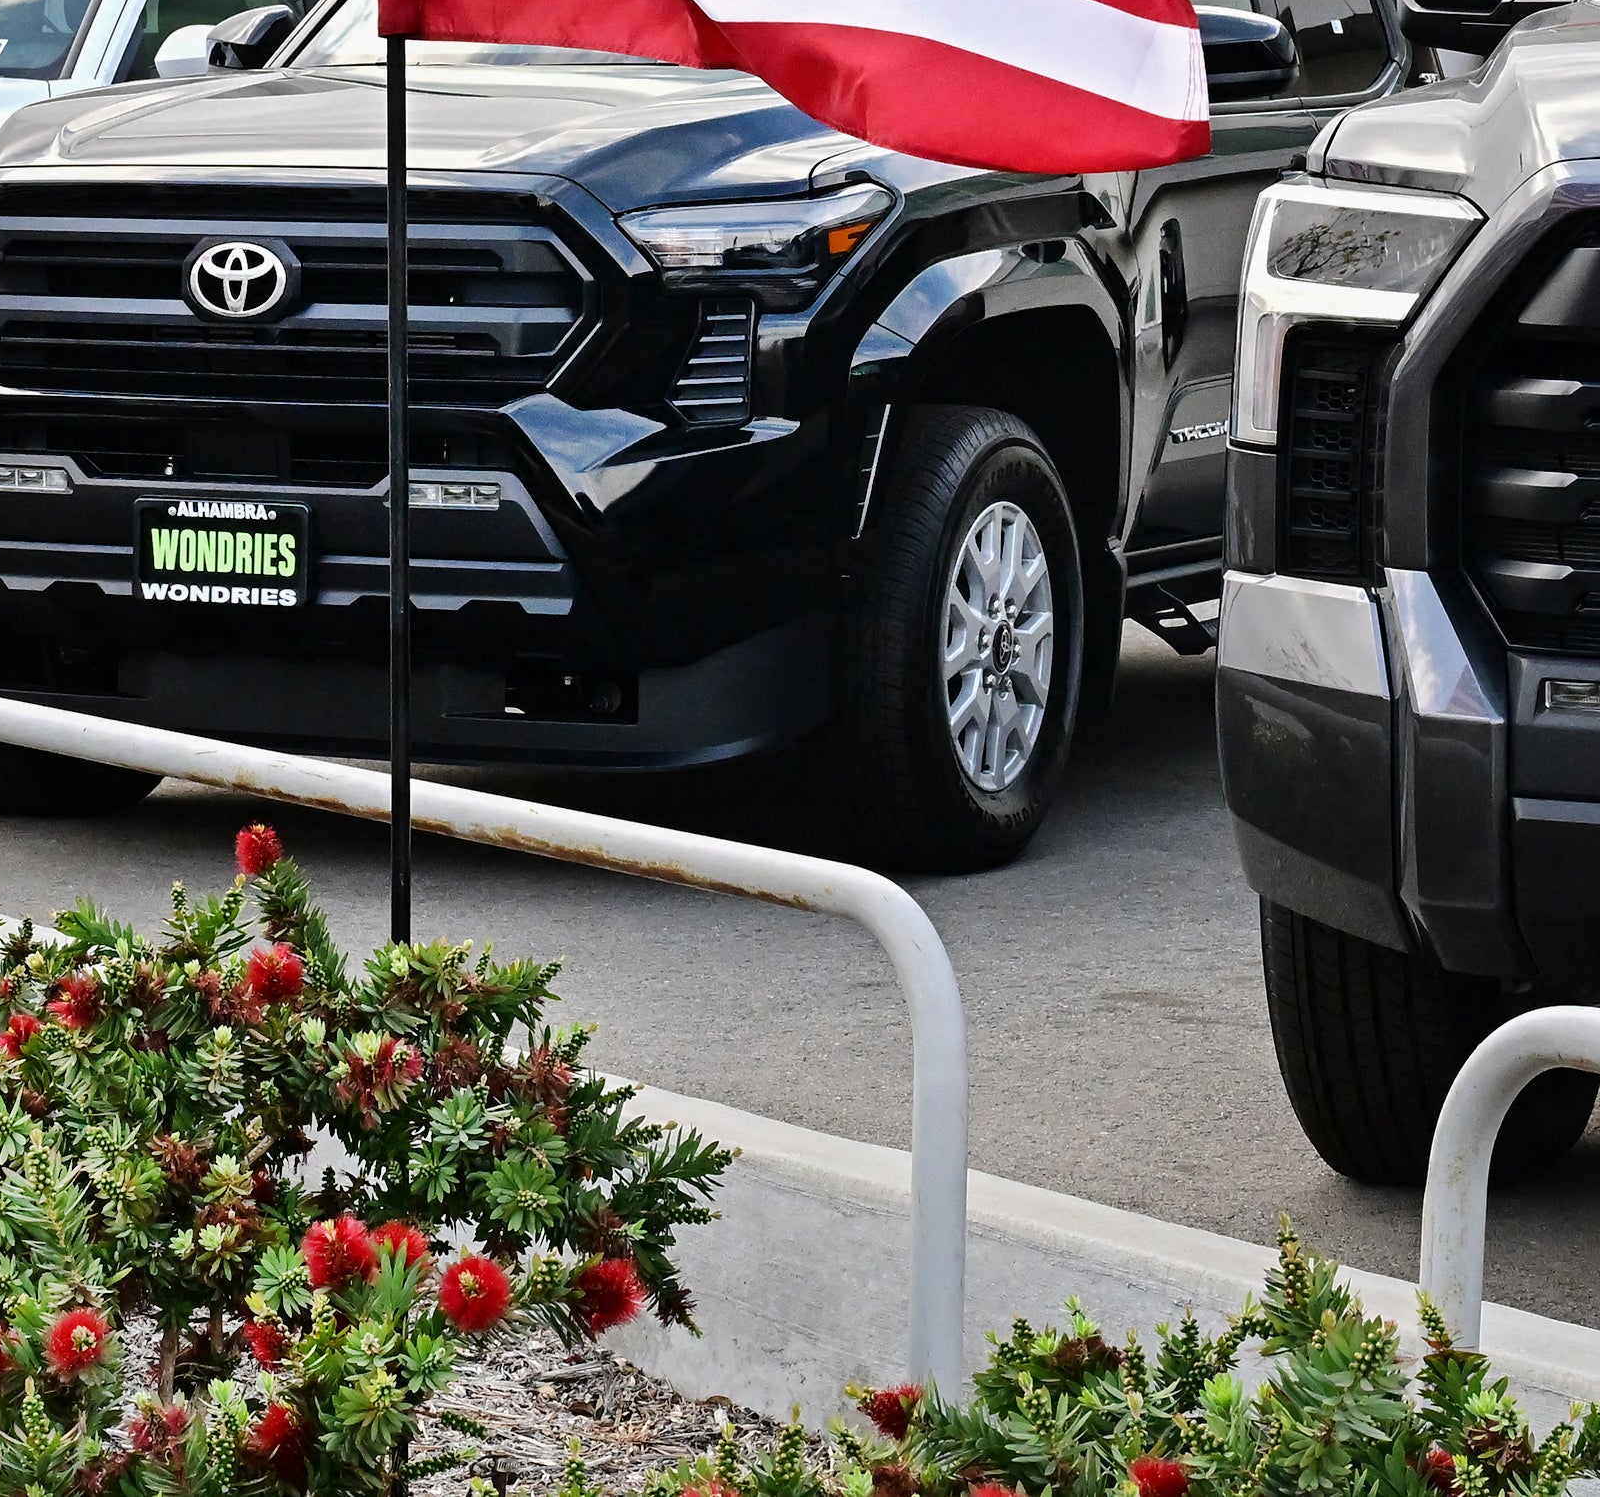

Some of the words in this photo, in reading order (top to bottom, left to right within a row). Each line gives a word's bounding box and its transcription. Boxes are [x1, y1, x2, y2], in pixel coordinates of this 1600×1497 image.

[1169, 420, 1229, 442] TACOM
[177, 502, 268, 520] ALHAMBRA
[151, 528, 296, 577] WONDRIES
[141, 582, 297, 606] WONDRIES
